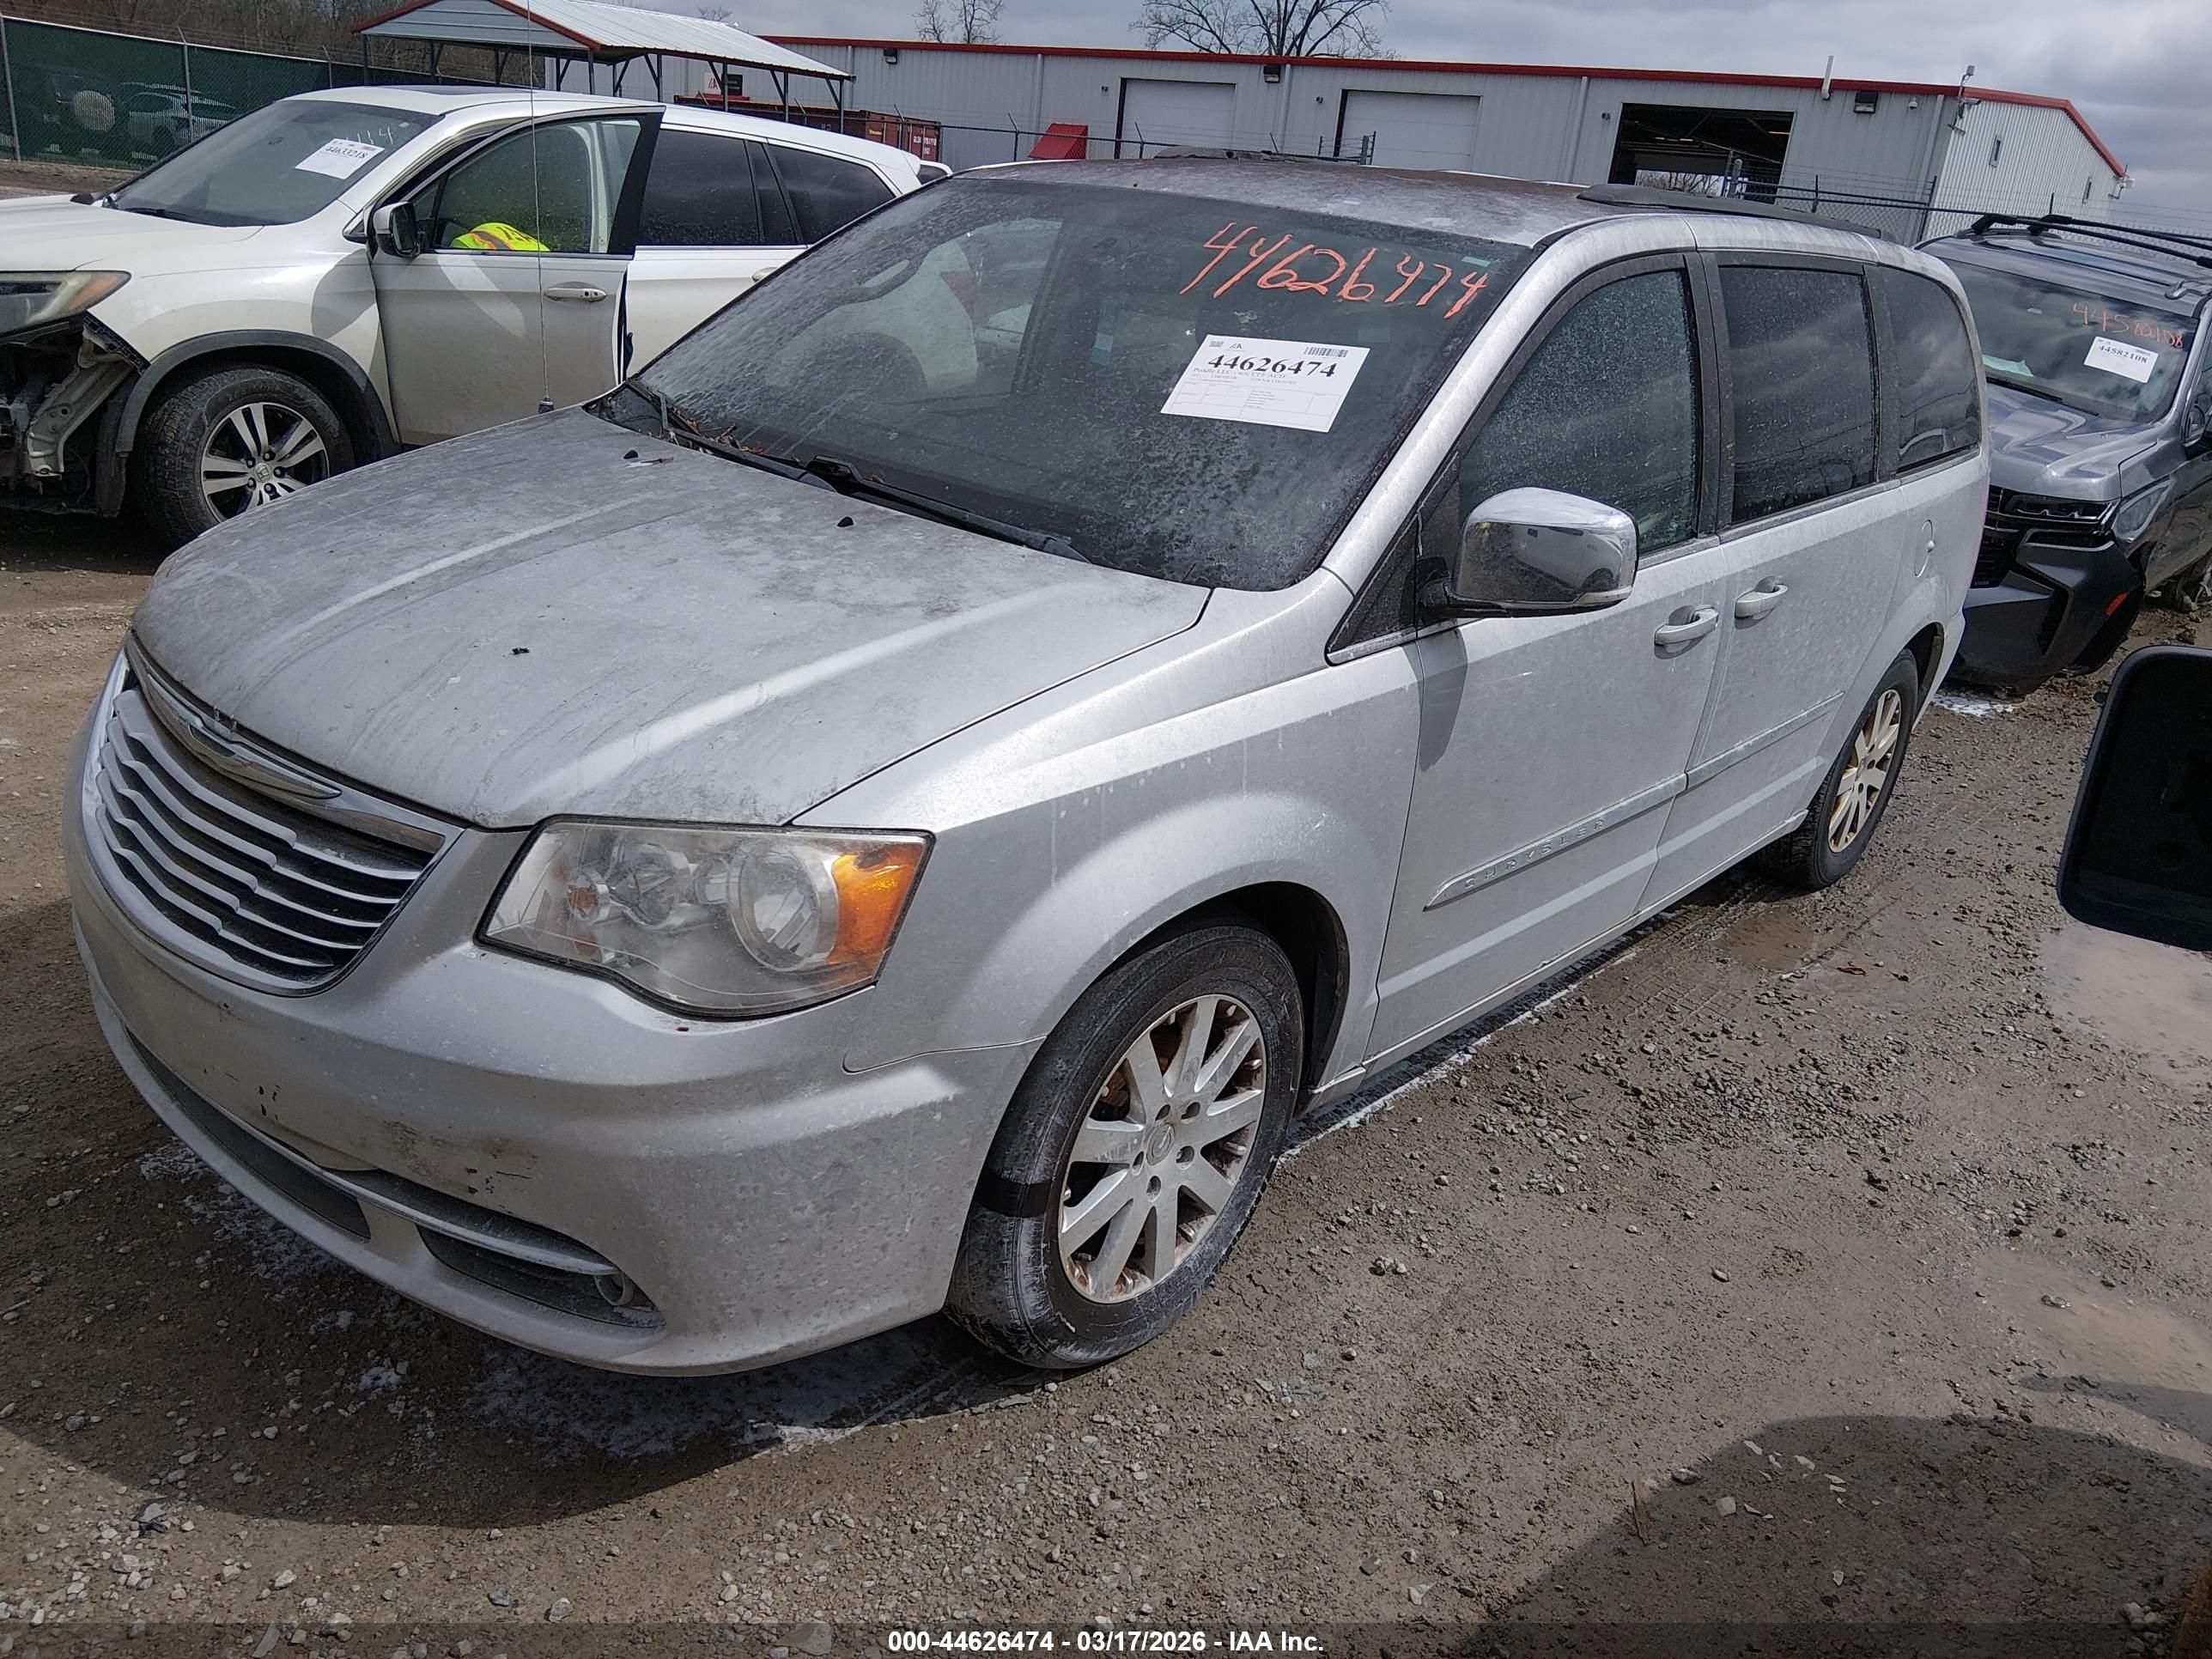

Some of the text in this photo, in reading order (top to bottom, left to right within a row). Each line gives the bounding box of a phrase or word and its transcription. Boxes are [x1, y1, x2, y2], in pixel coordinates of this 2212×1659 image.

[1180, 222, 1490, 319] 44626474
[1207, 354, 1338, 378] 44626474
[2098, 344, 2148, 364] 44582108
[1464, 818, 1605, 890] CHRYSLER
